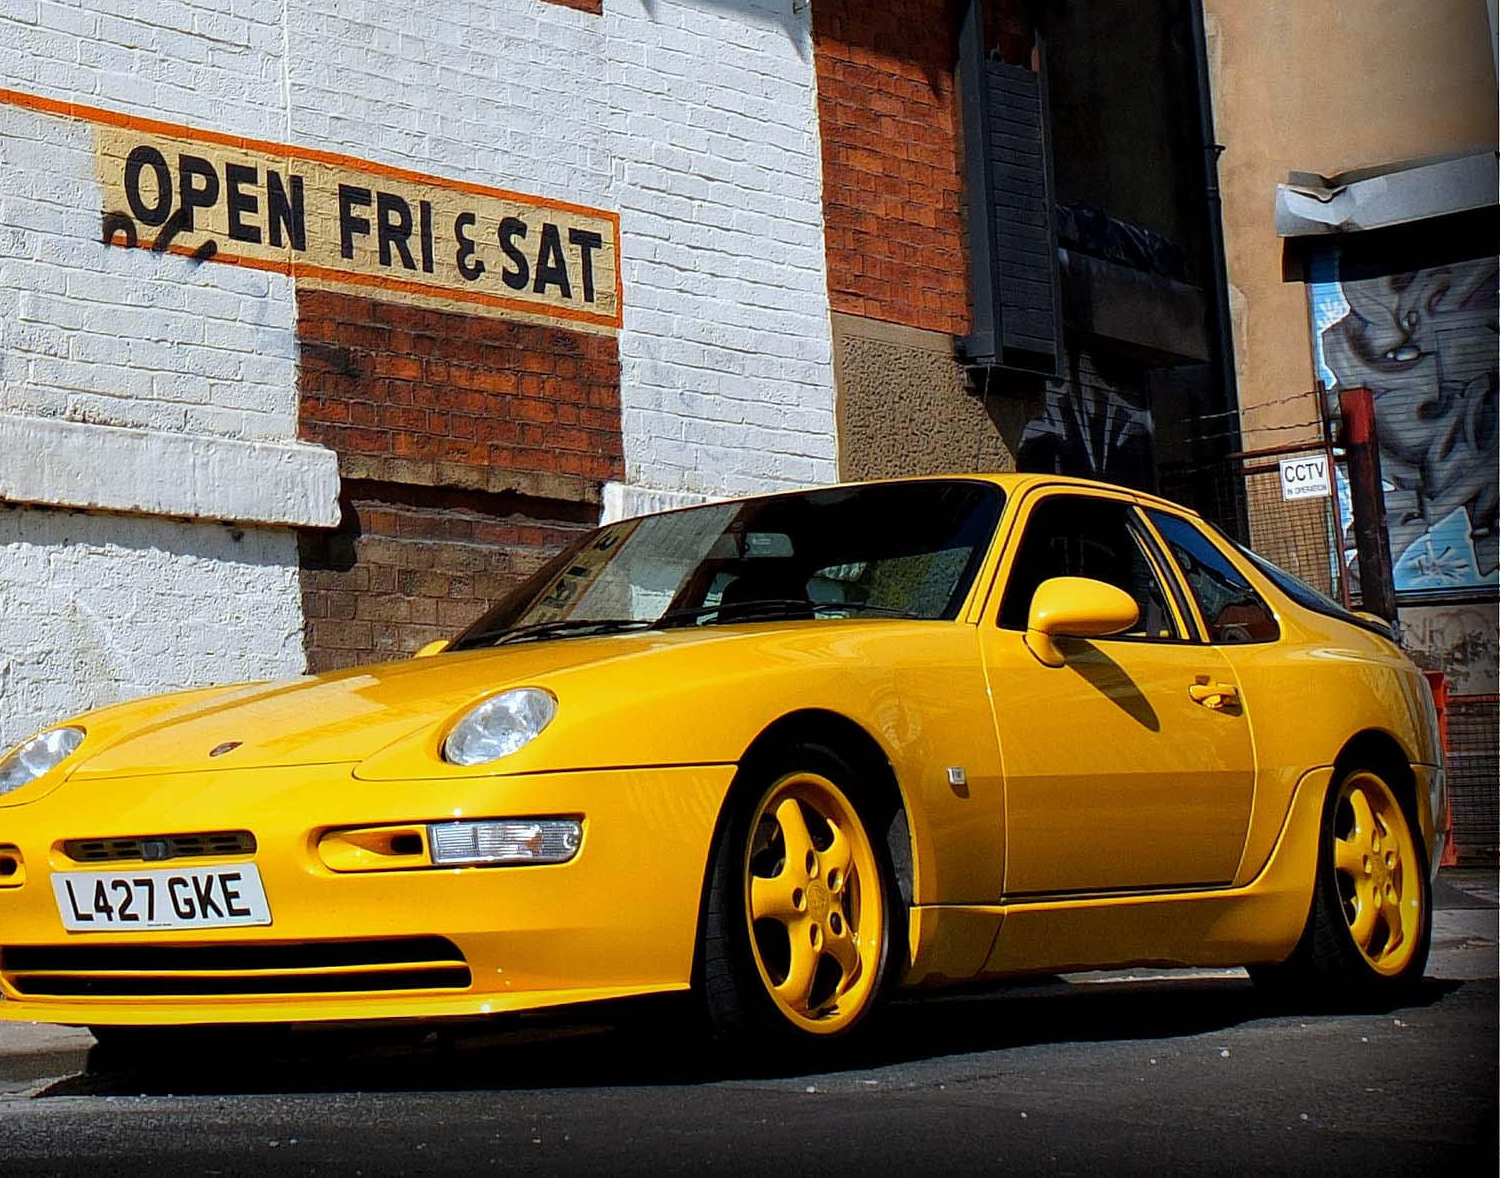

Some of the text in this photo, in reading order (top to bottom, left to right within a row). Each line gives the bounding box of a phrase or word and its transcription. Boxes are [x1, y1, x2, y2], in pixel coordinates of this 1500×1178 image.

[123, 145, 603, 303] OPEN FRI & SAT
[1284, 461, 1325, 483] CCTV
[65, 872, 252, 922] L427 GKE
